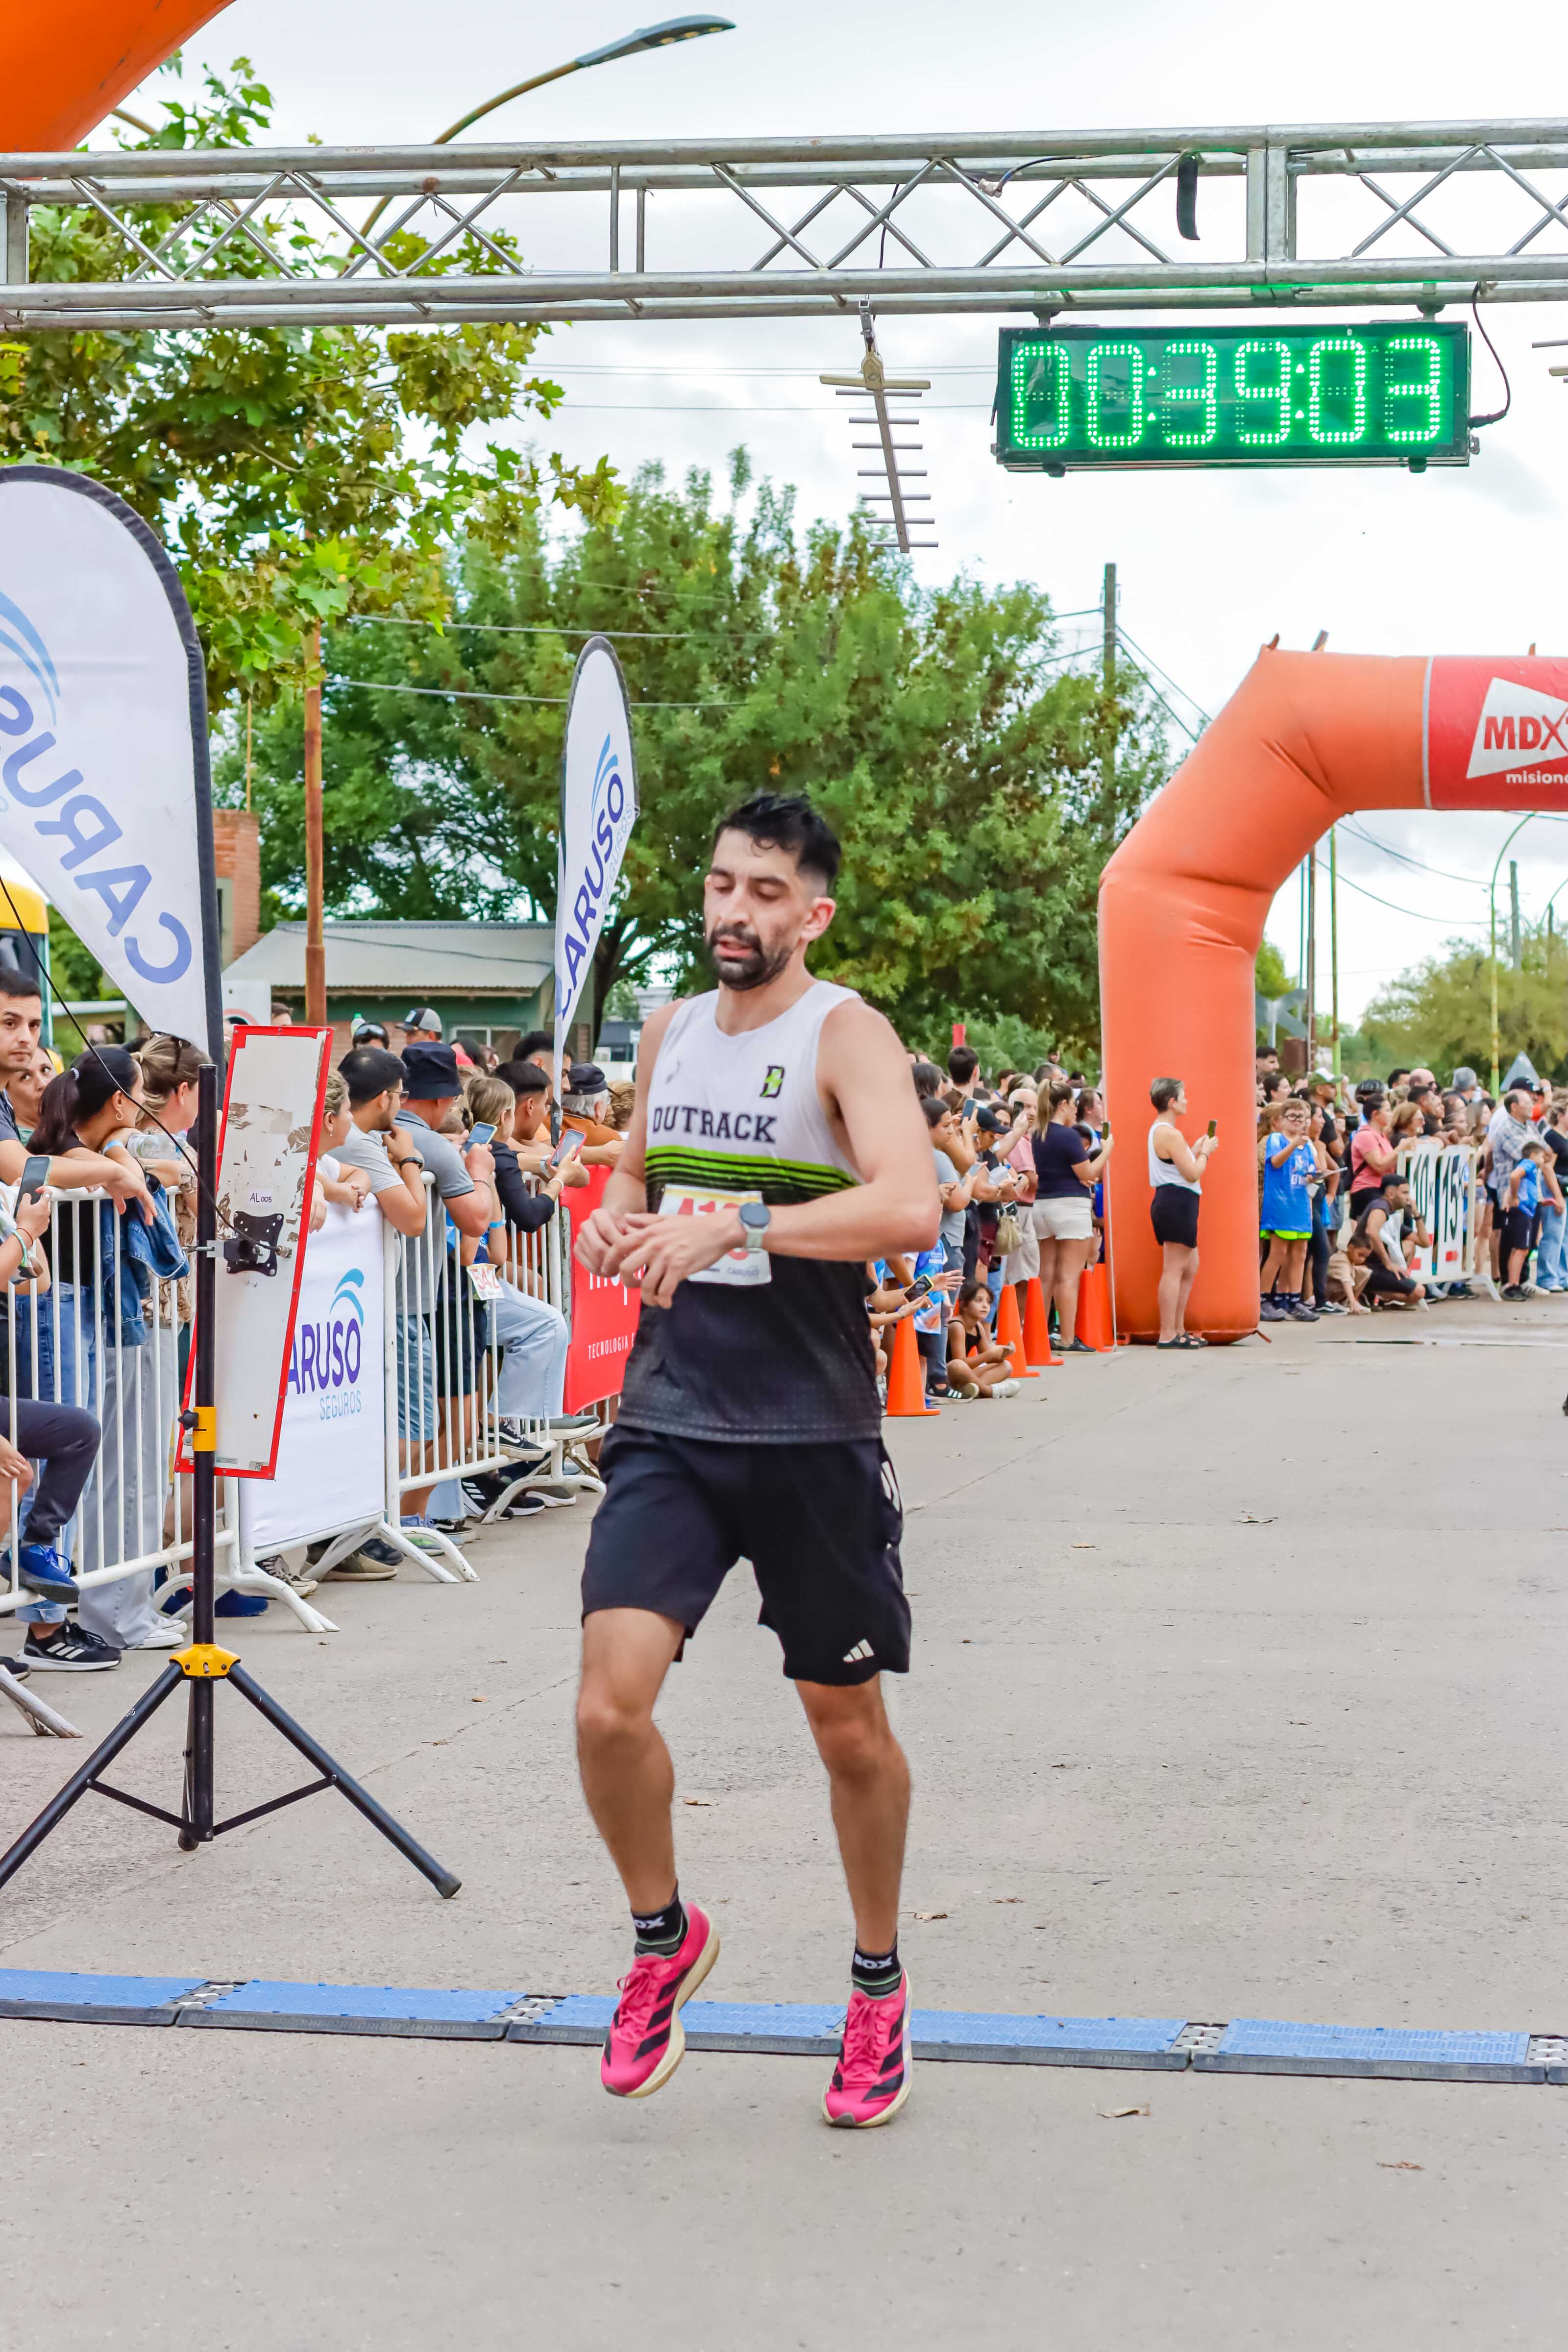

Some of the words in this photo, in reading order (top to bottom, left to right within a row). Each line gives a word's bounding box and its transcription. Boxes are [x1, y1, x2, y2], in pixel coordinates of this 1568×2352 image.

[1014, 337, 1441, 448] 00:39:03
[1484, 707, 1568, 752] MDX
[588, 1335, 629, 1360] TECNOLOGIA
[319, 1390, 361, 1420] SEGUROS
